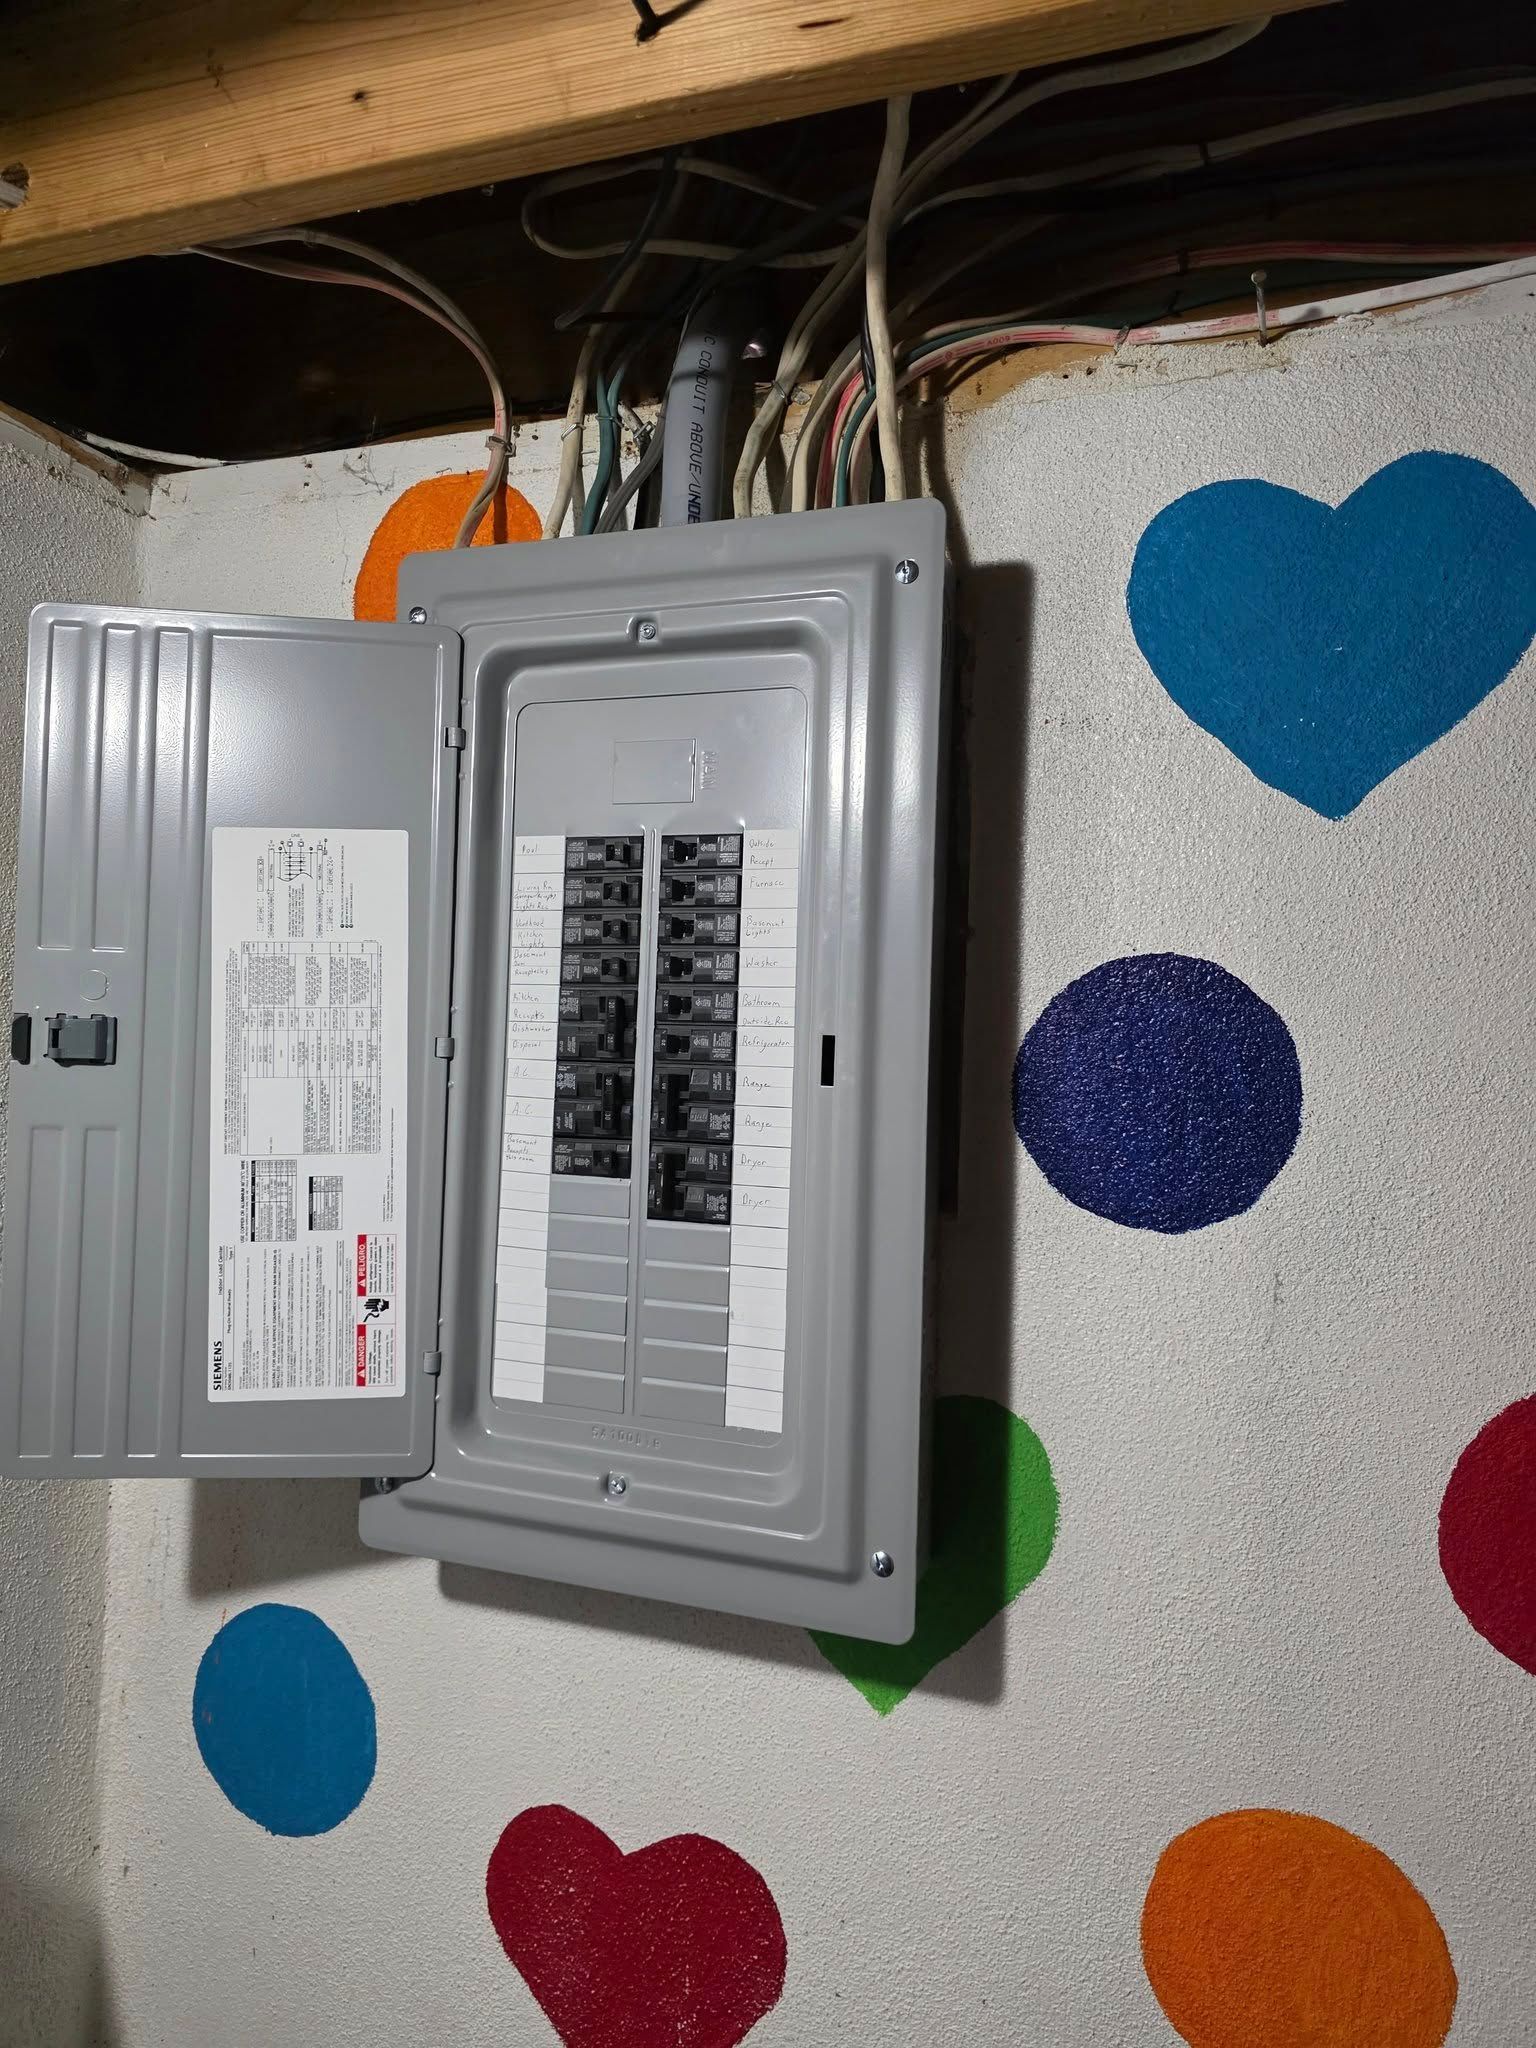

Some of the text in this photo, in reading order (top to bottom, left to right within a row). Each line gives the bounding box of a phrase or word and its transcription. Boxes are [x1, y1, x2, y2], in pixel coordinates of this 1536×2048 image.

[986, 335, 1011, 346] 600V
[693, 350, 713, 415] CONDUIT
[745, 956, 778, 968] Washer
[742, 993, 780, 1007] Bathroom
[742, 1076, 770, 1091] Range
[745, 1114, 772, 1132] Range
[741, 1153, 767, 1170] Dryer
[742, 1192, 770, 1209] Dryer
[213, 1341, 222, 1390] SIEMENS
